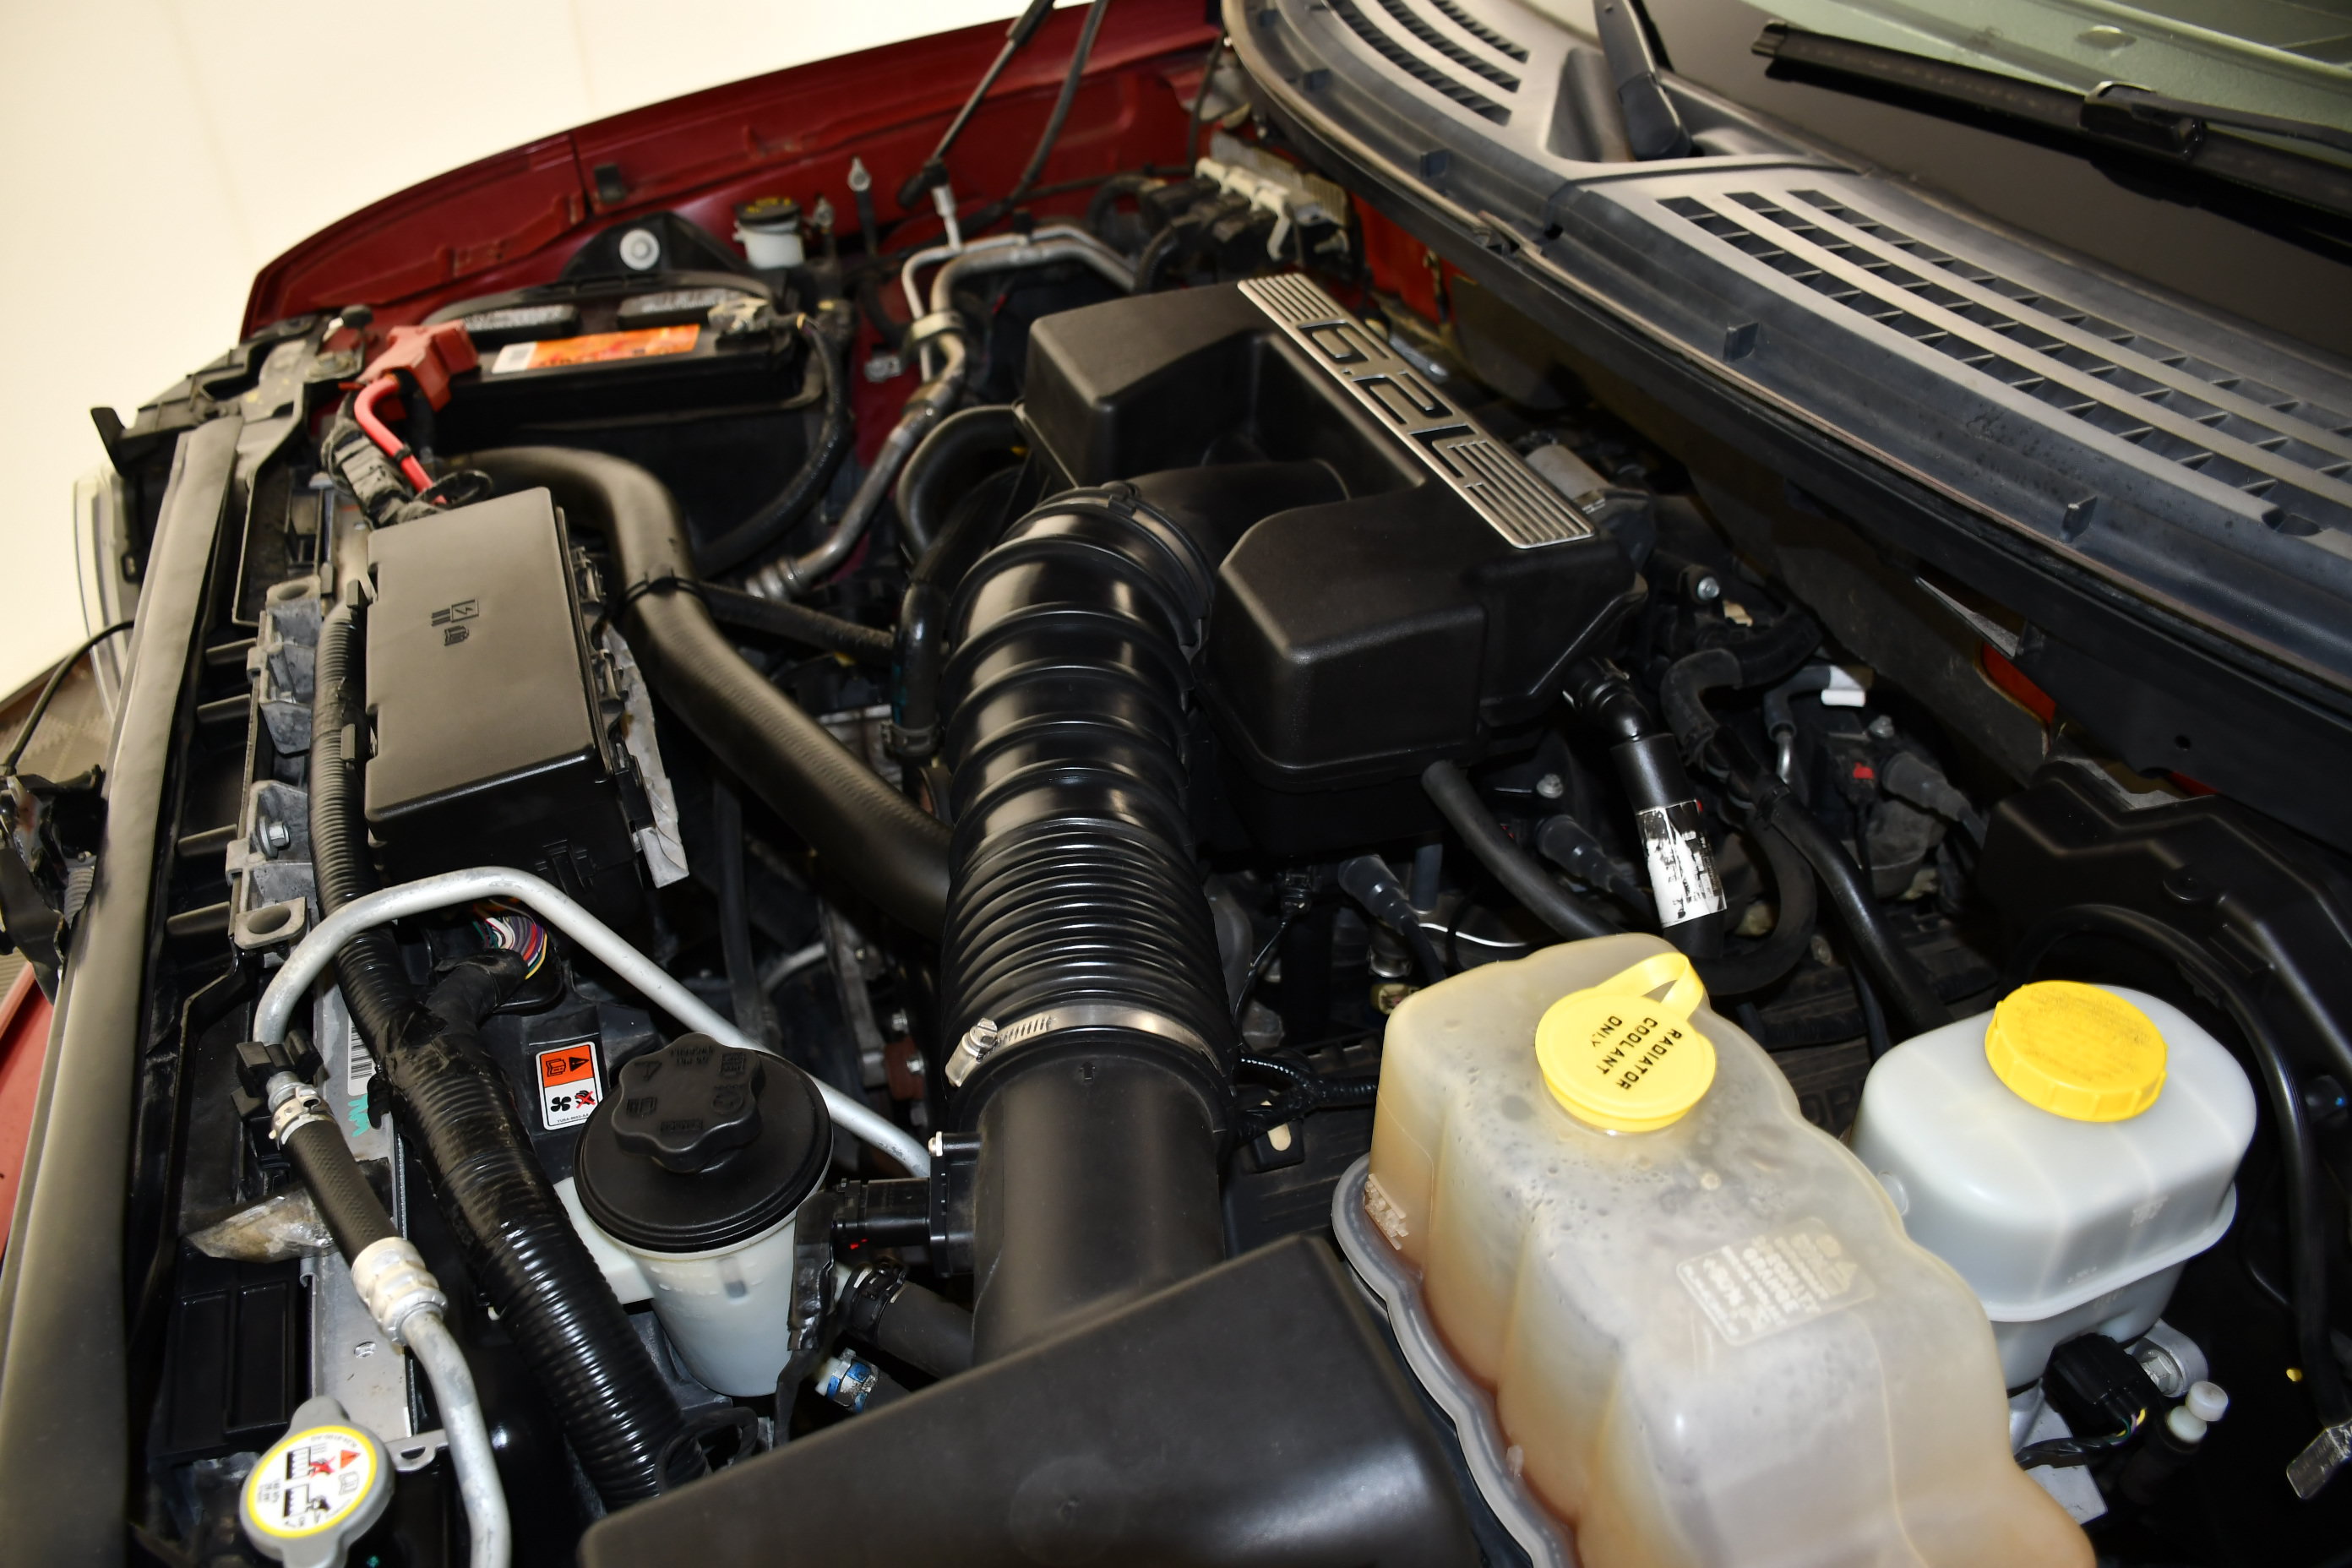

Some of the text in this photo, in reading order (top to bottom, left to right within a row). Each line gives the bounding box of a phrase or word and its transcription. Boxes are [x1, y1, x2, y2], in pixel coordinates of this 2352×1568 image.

[1298, 319, 1478, 479] 6.2L
[1591, 1015, 1623, 1048] ONLY
[1596, 1017, 1658, 1075] COOLANT
[1616, 1028, 1683, 1090] RADIATOR
